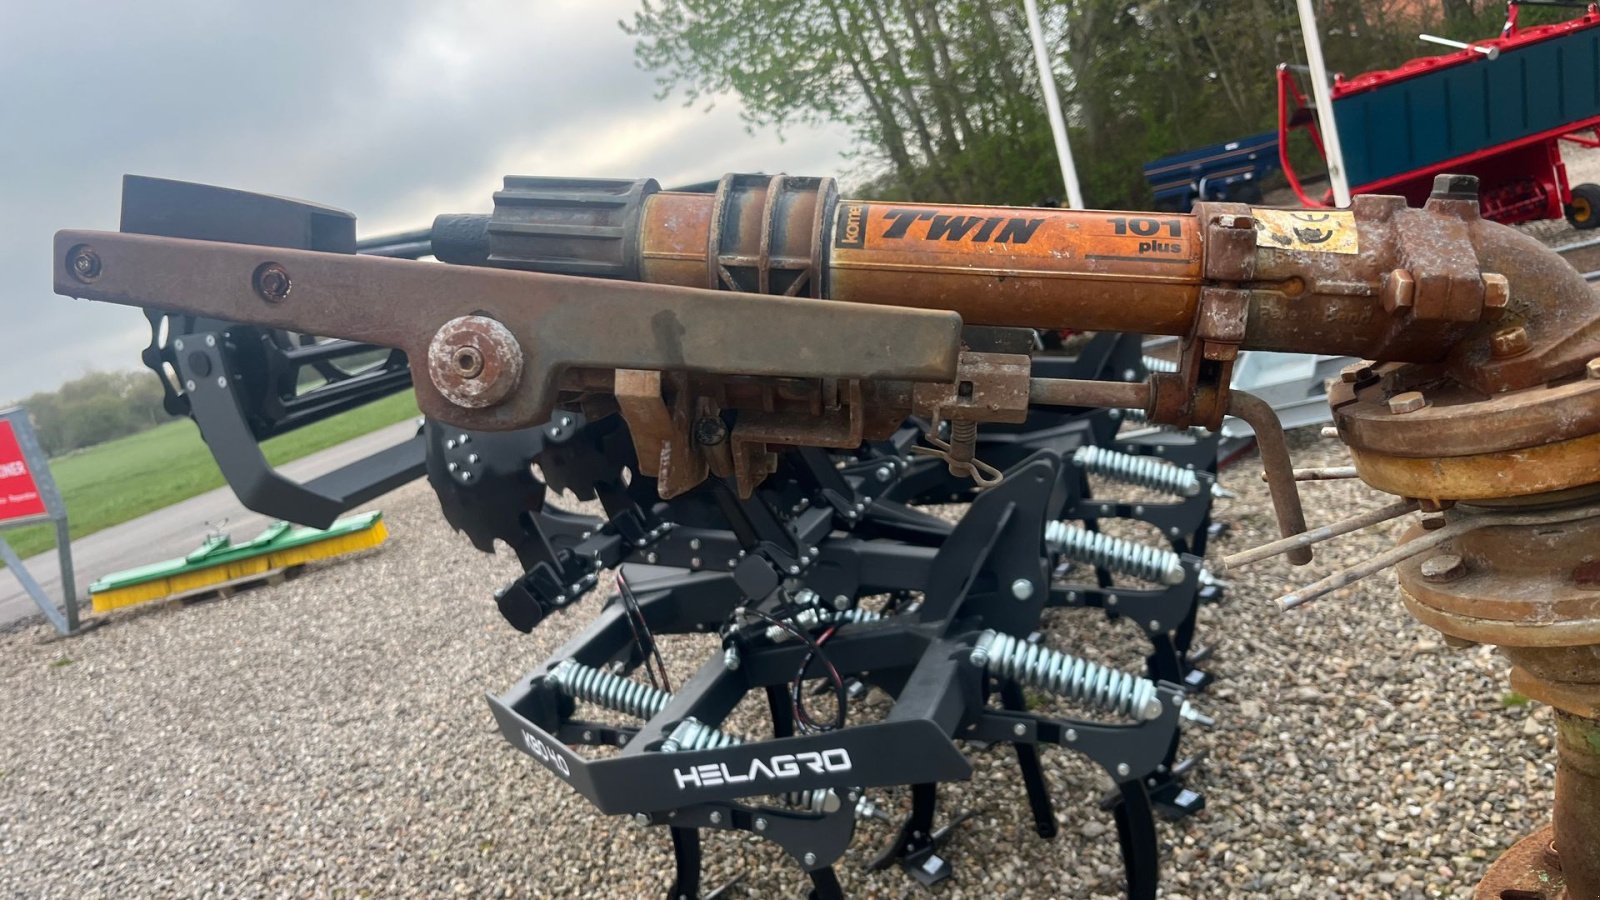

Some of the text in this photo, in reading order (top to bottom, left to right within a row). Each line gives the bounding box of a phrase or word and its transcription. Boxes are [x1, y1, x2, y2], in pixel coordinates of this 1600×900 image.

[882, 209, 1182, 244] TWIN 101
[1138, 239, 1182, 254] plus
[673, 748, 852, 790] HELAGRO
